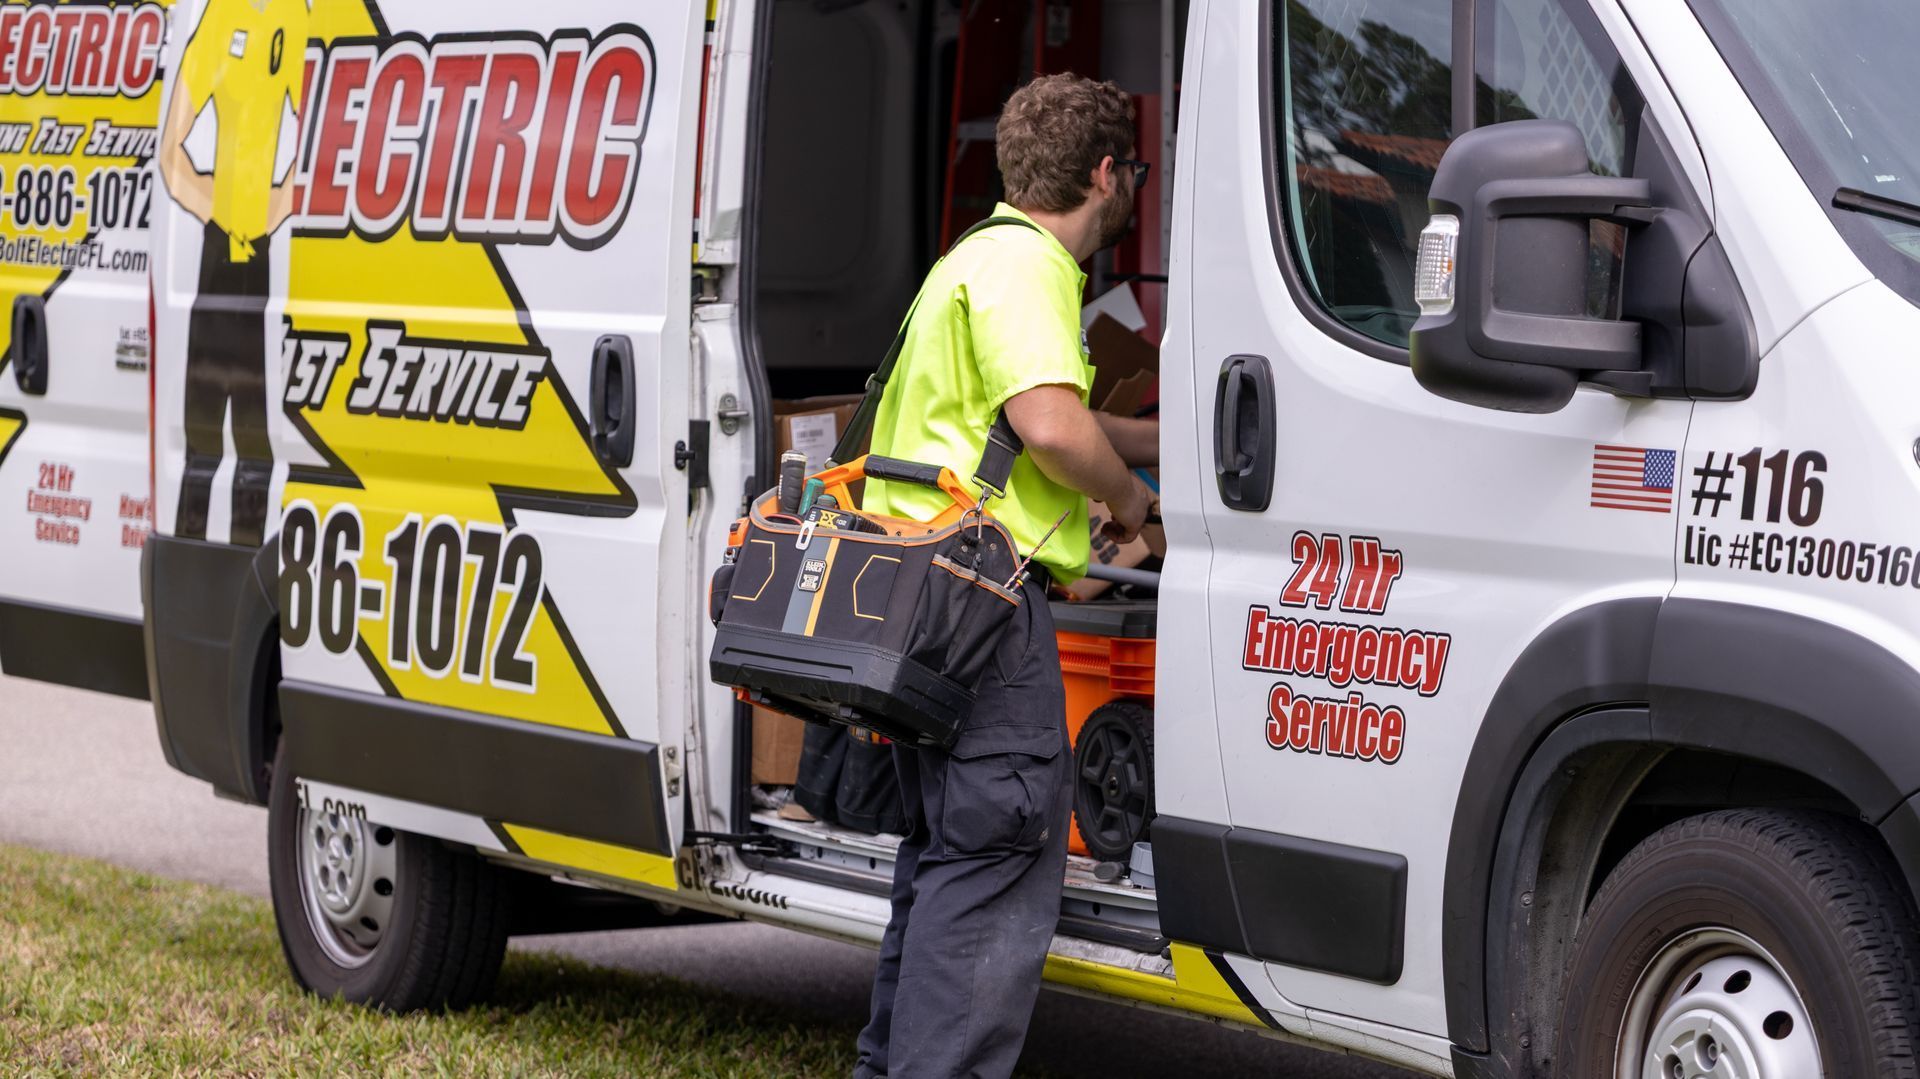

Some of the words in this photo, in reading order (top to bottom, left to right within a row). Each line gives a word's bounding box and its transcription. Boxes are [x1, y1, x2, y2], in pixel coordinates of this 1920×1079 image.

[0, 7, 164, 94] ECTRIC
[83, 118, 158, 157] SERVIC
[0, 166, 153, 229] -886-1072
[347, 326, 549, 424] SERVICE
[27, 488, 92, 521] Emergency
[38, 462, 56, 489] 24
[1691, 446, 1828, 527] #116
[35, 517, 80, 545] Service
[1684, 525, 1722, 567] Lic
[279, 503, 544, 689] 86-1072
[1281, 532, 1341, 608] 24
[1340, 536, 1402, 614] Hr
[1243, 605, 1451, 697] Emergency
[1266, 682, 1406, 765] Service
